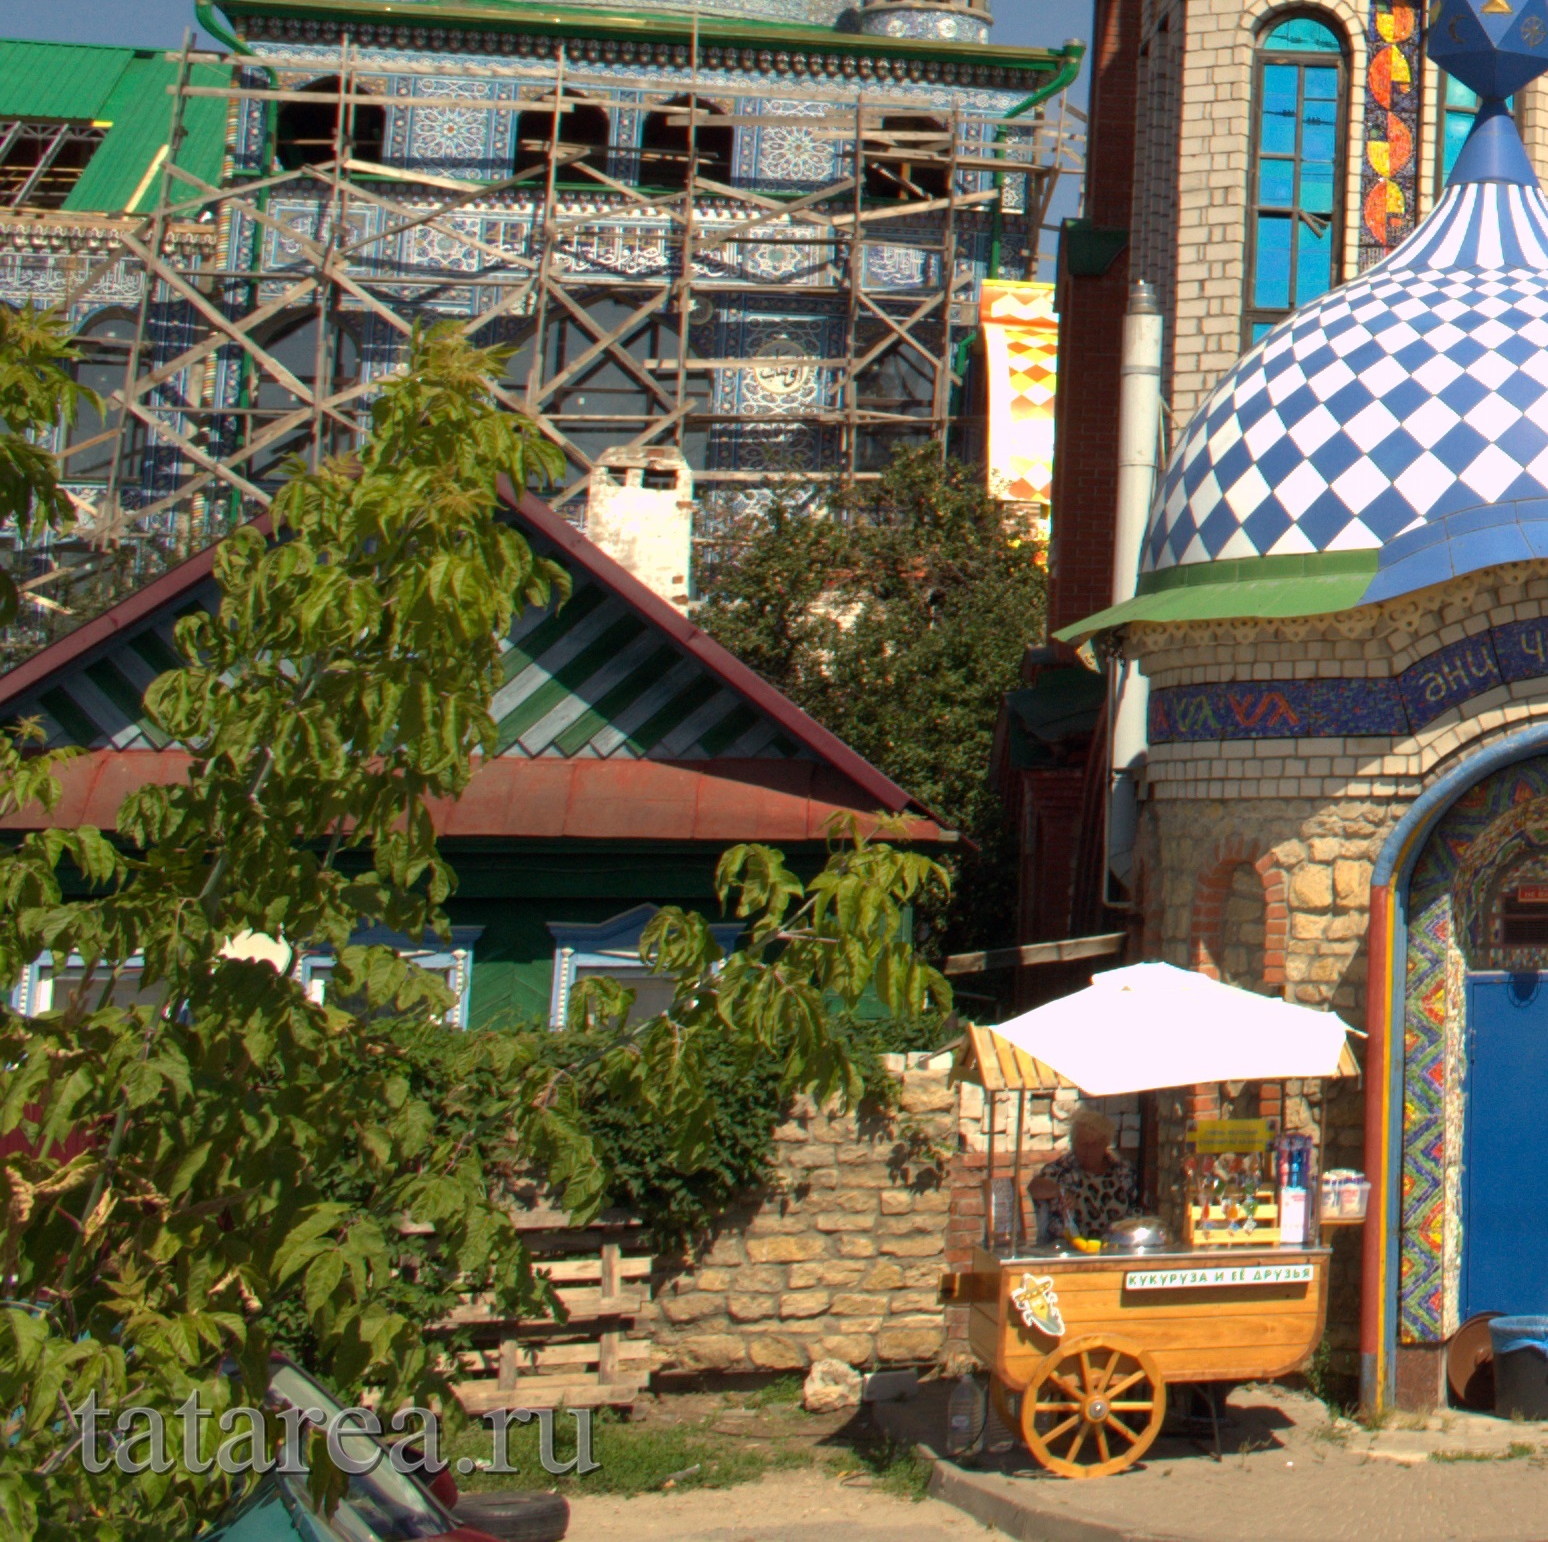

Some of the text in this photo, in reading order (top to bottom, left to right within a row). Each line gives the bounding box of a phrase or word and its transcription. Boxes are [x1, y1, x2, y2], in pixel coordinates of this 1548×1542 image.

[1128, 1267, 1311, 1286] КУКУРУЗА И ЕЁ ДРУЗЬЯ
